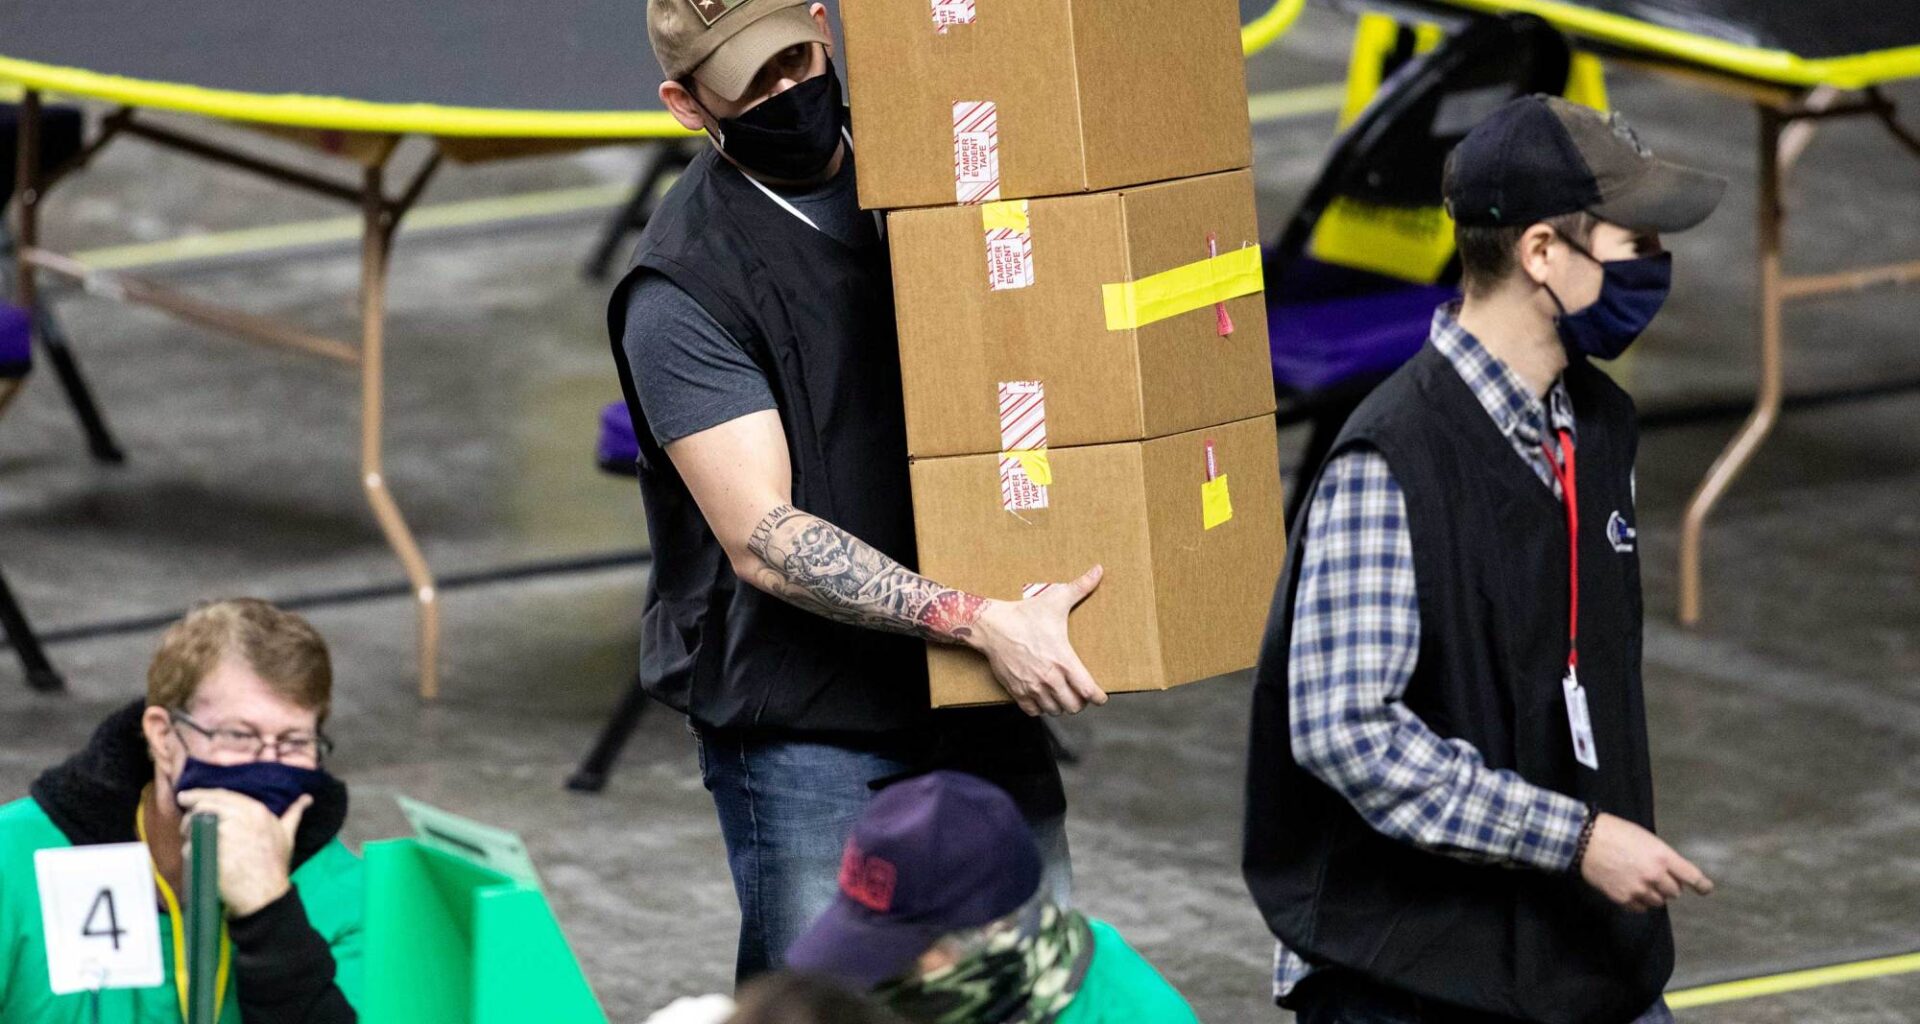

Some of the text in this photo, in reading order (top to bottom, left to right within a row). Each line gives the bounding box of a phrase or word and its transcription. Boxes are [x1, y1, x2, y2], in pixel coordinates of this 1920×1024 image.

[962, 137, 970, 177] TAMPER
[970, 136, 979, 178] EVIDENT
[979, 145, 987, 170] TAPE
[997, 245, 1005, 284] TAMPER
[1004, 244, 1014, 284] EVIDENT
[1013, 251, 1021, 276] TAPE
[1030, 481, 1039, 503] TAP
[82, 888, 126, 950] 4
